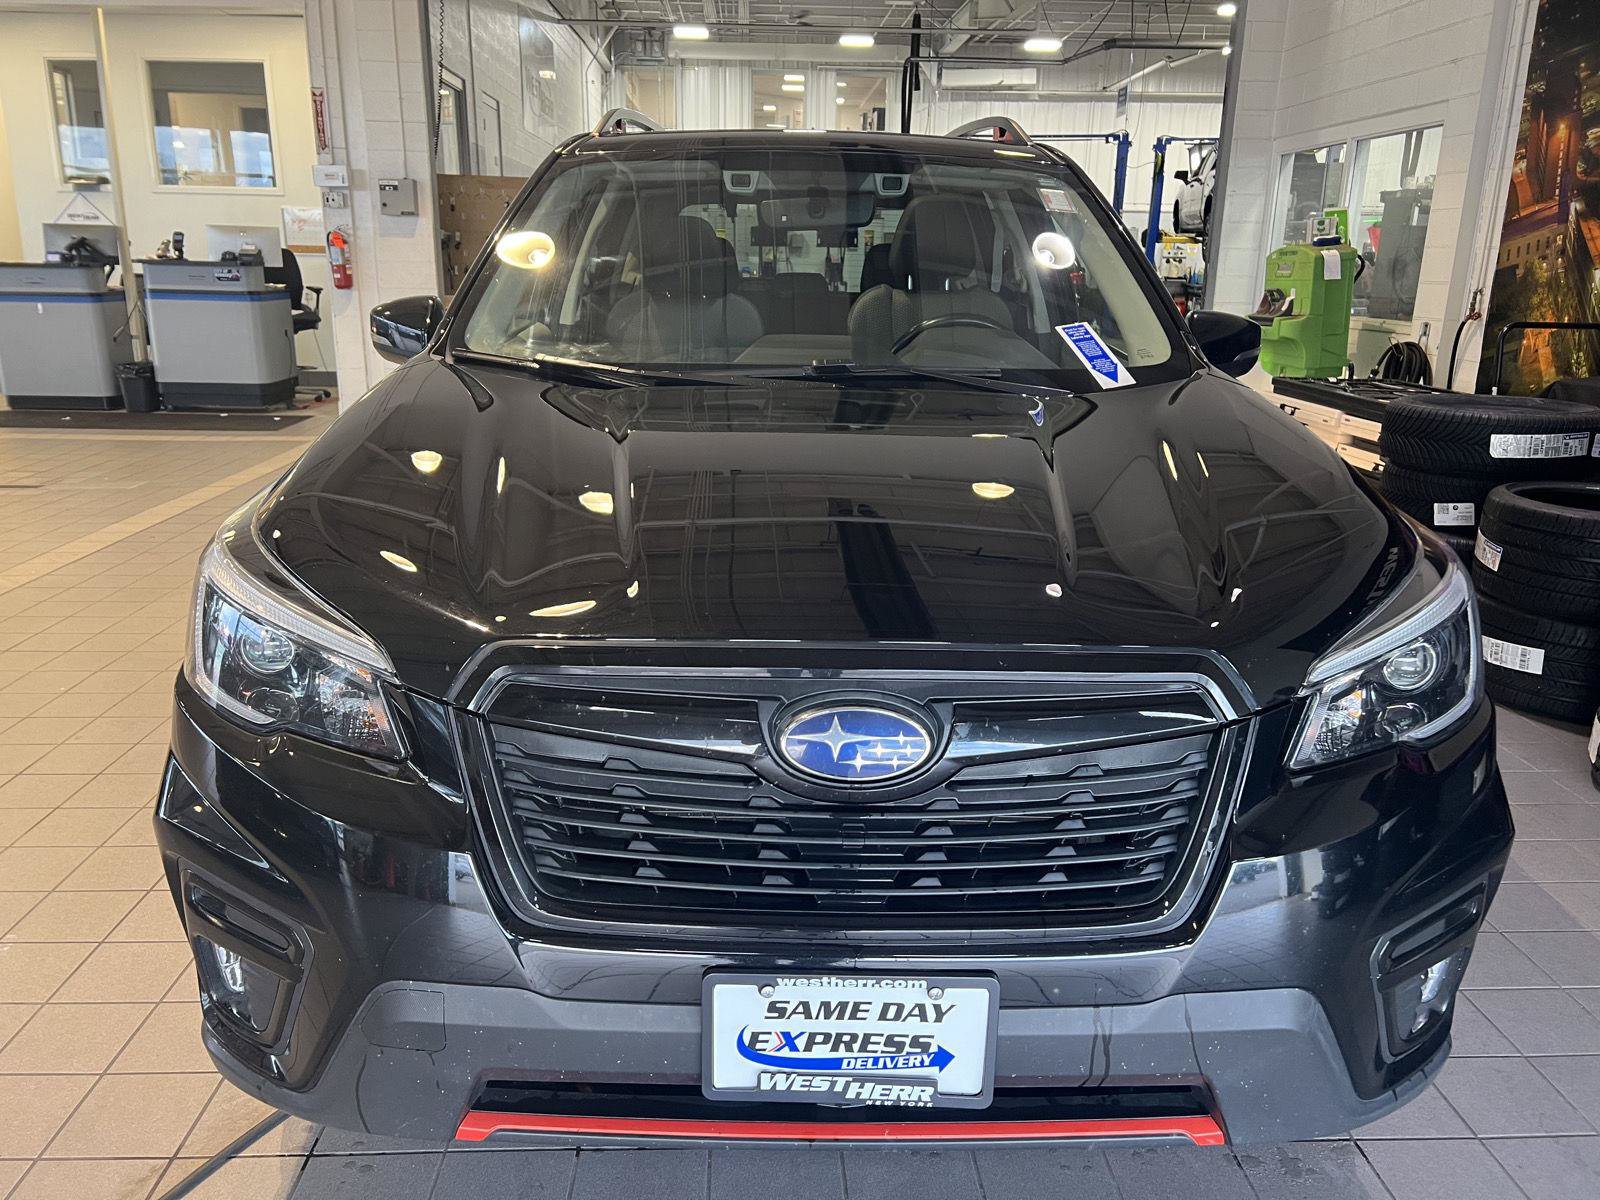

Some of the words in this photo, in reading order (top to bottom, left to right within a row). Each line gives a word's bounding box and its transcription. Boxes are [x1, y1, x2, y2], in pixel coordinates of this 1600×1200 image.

[776, 977, 928, 990] westherr.com
[764, 1000, 873, 1021] SAME
[877, 1002, 956, 1023] DAY
[747, 1031, 935, 1054] EXPRESS
[841, 1053, 936, 1070] DELIVERY
[899, 1100, 934, 1108] YORK
